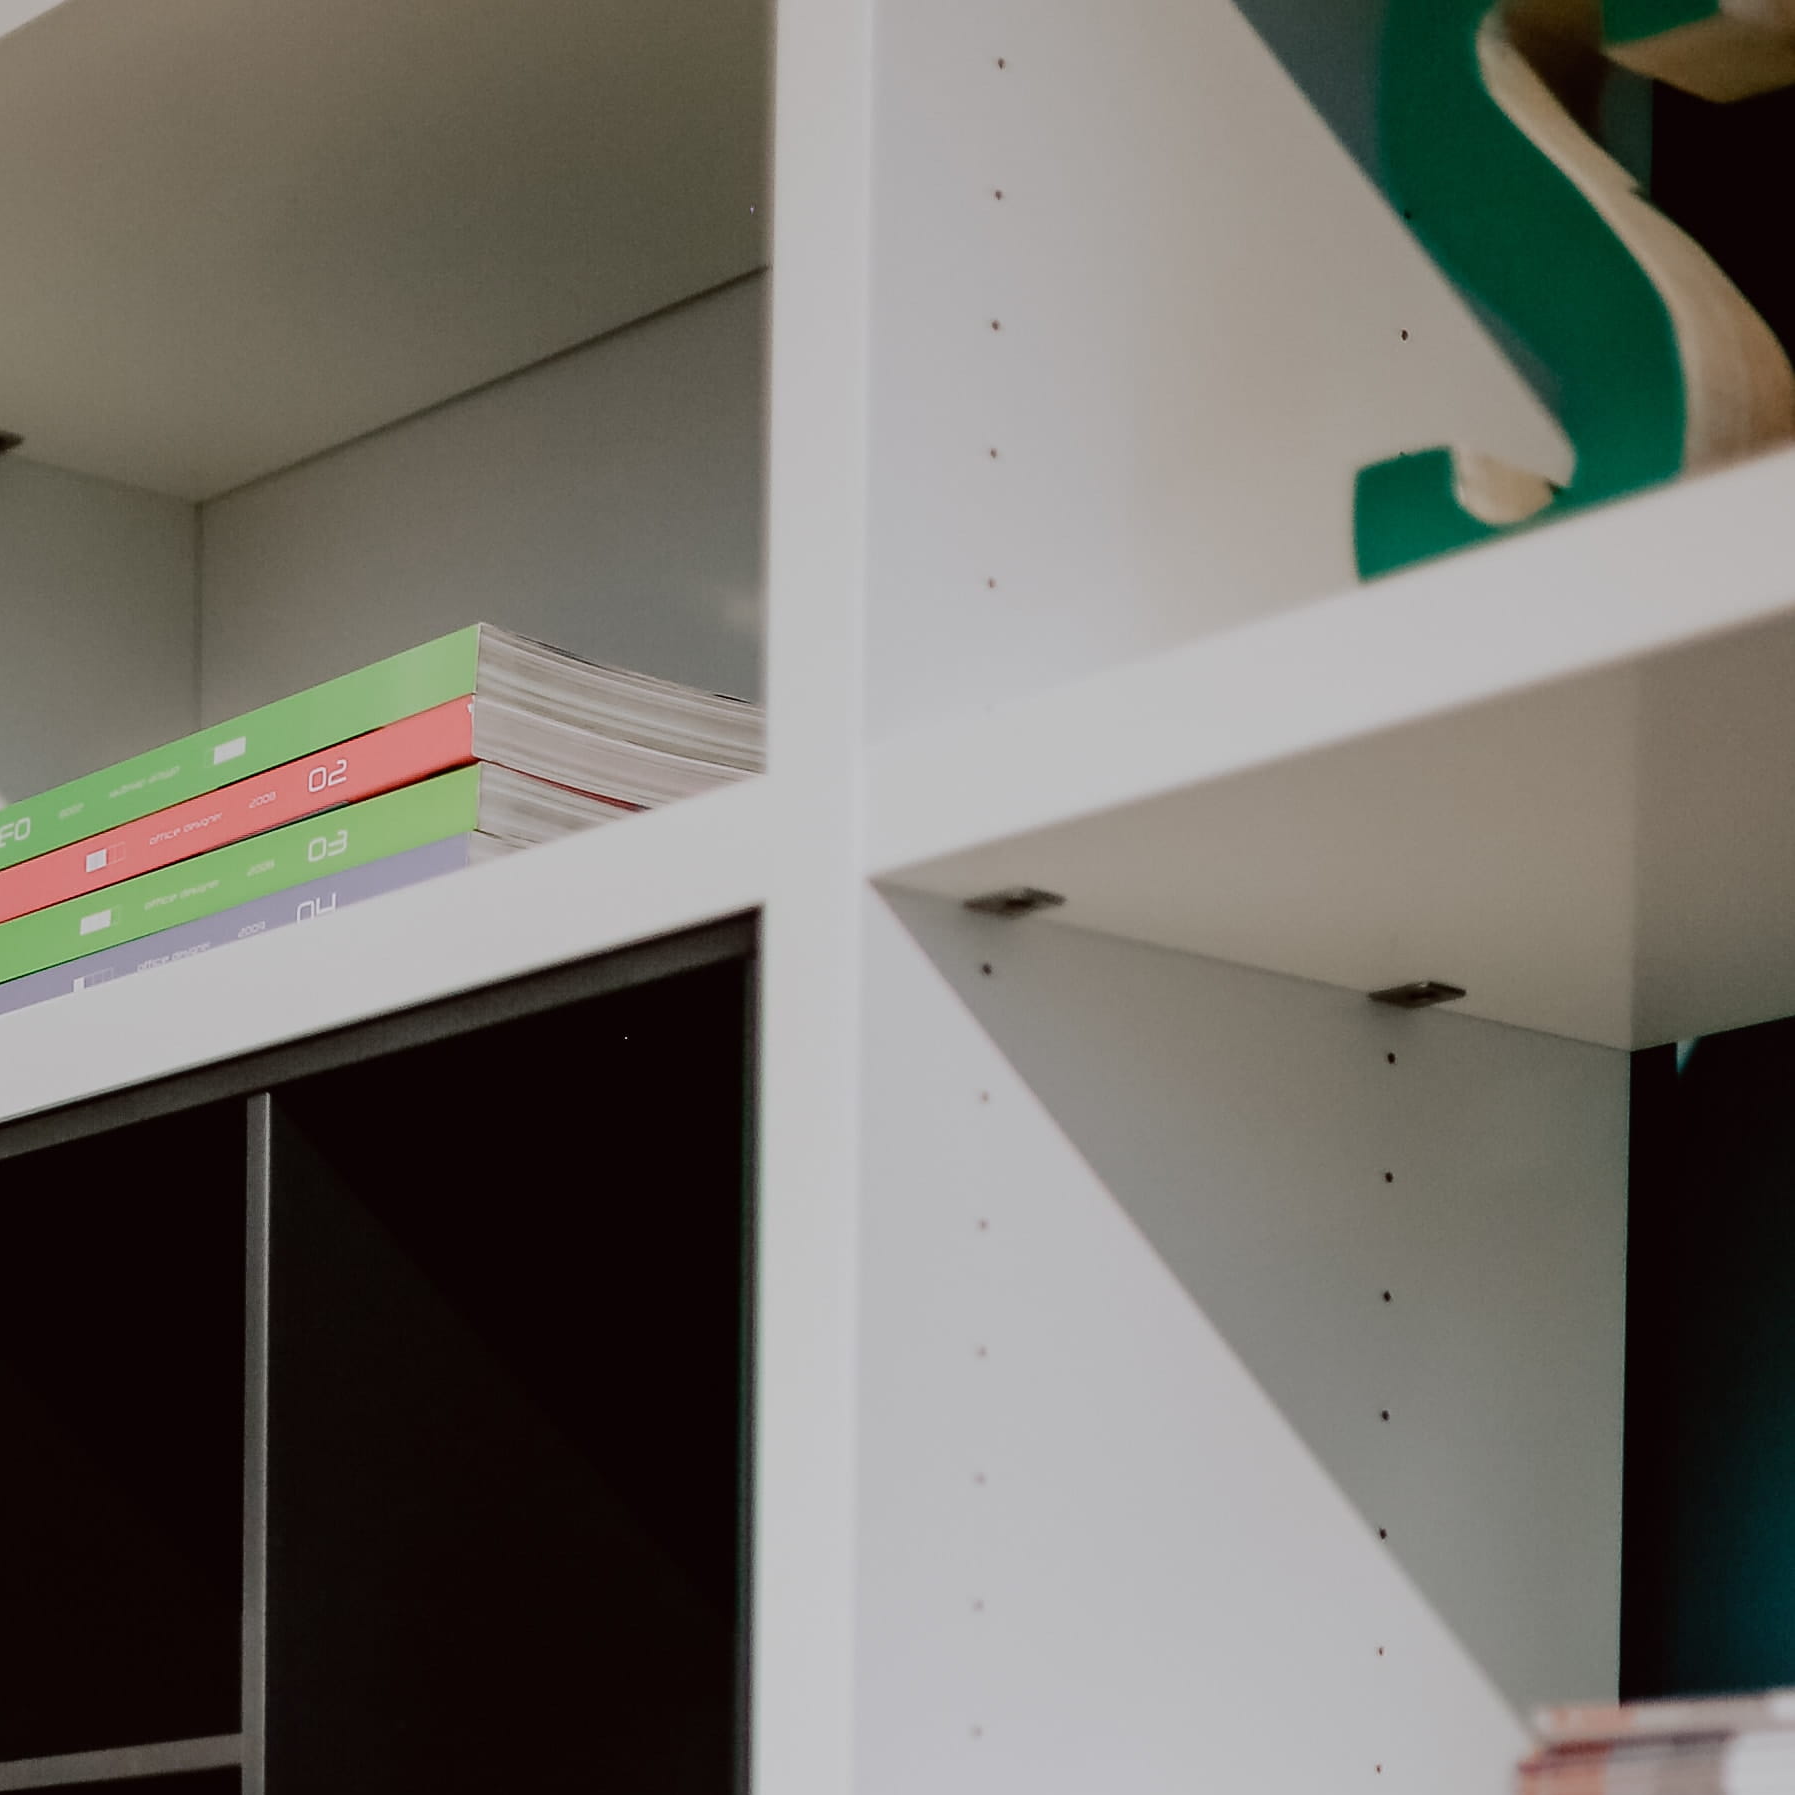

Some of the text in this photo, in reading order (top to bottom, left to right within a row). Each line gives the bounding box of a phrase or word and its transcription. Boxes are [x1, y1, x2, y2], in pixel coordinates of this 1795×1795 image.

[149, 827, 181, 846] office
[183, 813, 223, 833] designer
[308, 759, 348, 793] 02
[308, 829, 348, 862] 03
